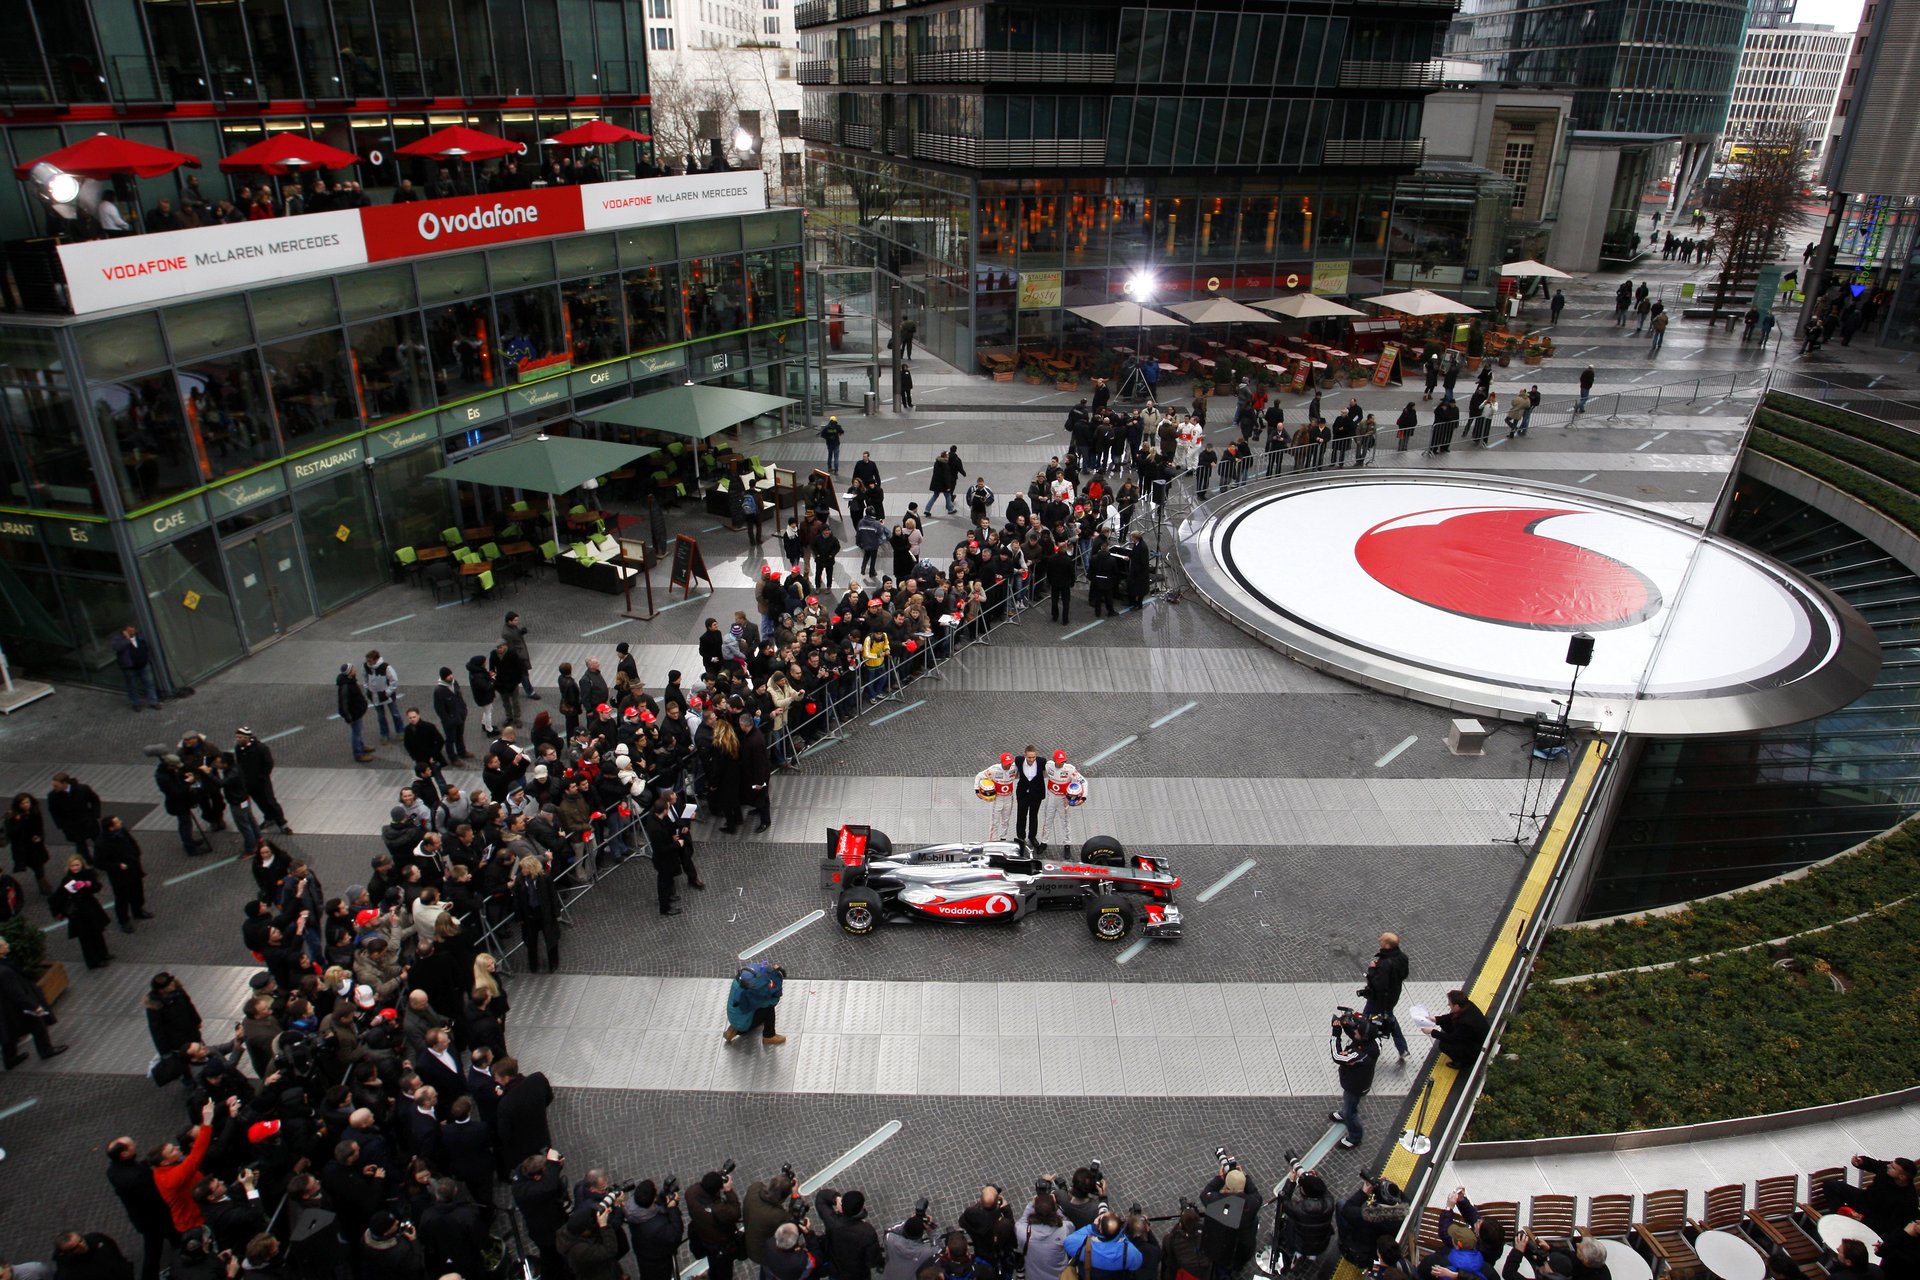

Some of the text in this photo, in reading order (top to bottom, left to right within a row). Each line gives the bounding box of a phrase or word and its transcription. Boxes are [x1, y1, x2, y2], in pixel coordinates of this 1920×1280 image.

[601, 187, 748, 209] VODAFONE McLAREN MERCEDES
[440, 203, 538, 234] vodafone
[102, 234, 340, 281] VODAFONE McLAREN MERCEDES
[1022, 283, 1057, 305] Josty
[712, 361, 724, 370] WC
[590, 370, 610, 385] CAFÉ
[295, 448, 357, 478] RESTAURANT
[153, 510, 186, 533] CAFÉ
[918, 853, 944, 862] Mobil
[832, 872, 841, 882] 3
[1062, 865, 1109, 874] vodafone
[939, 906, 984, 915] vodafone
